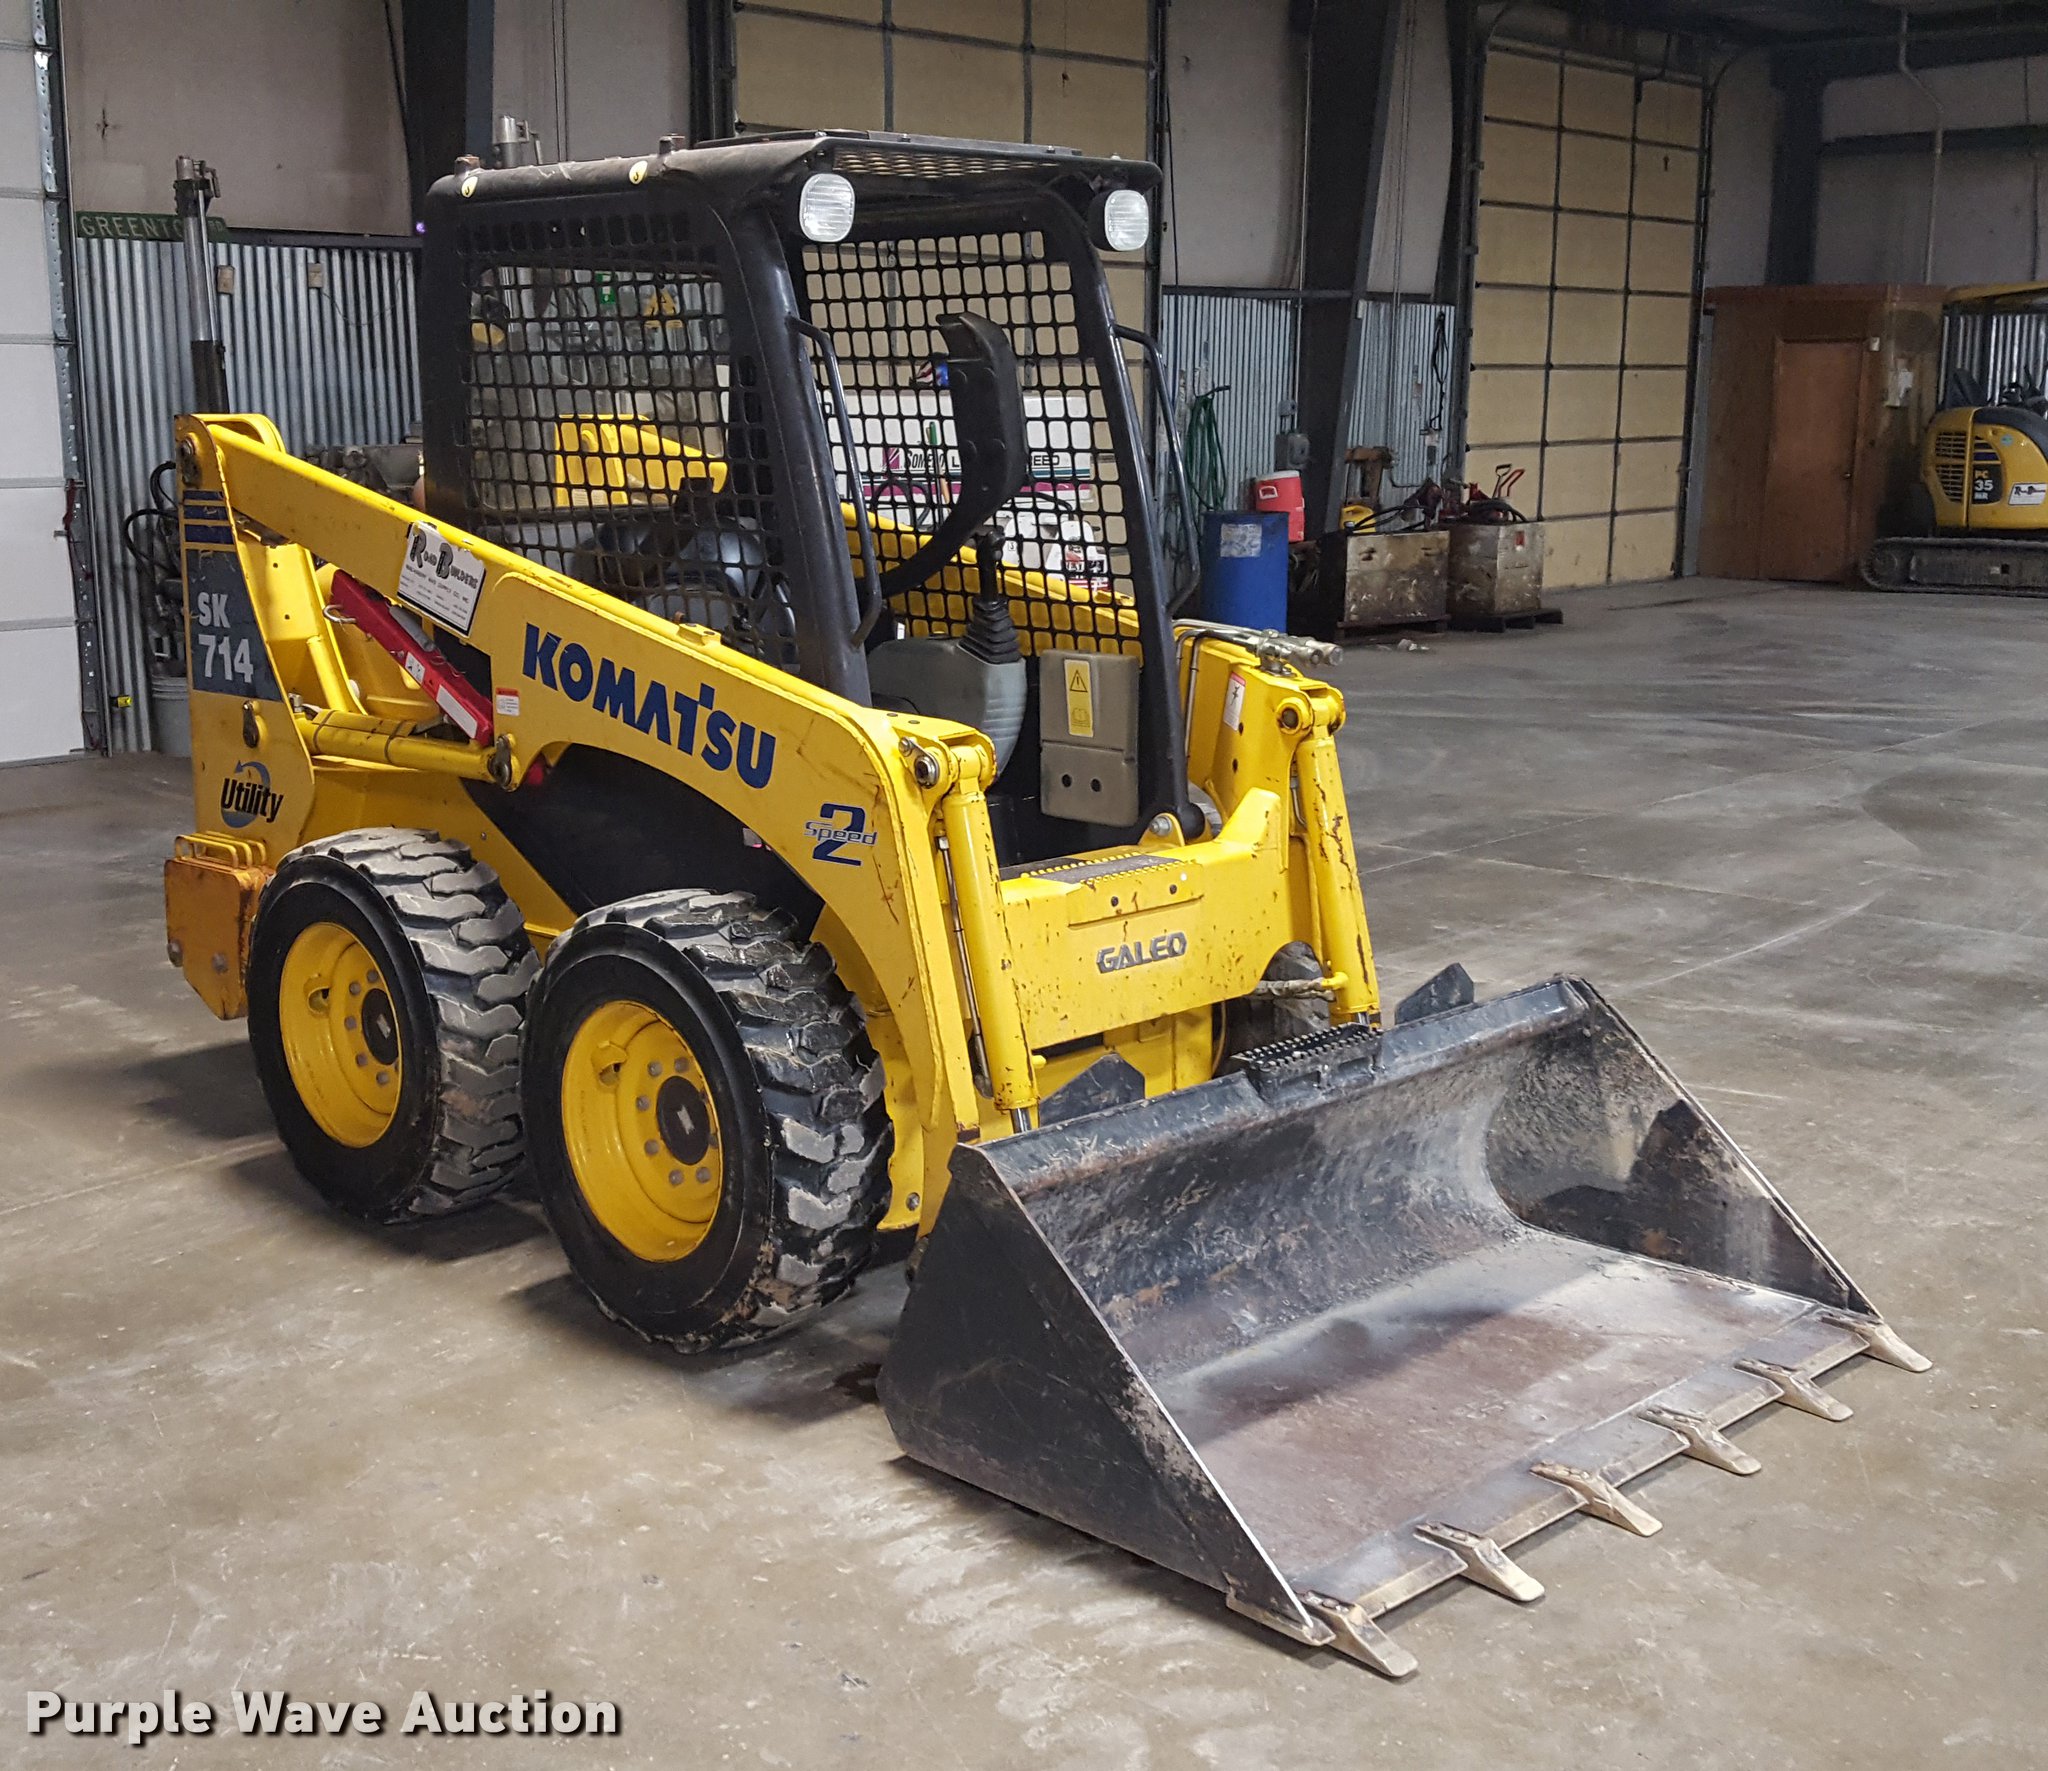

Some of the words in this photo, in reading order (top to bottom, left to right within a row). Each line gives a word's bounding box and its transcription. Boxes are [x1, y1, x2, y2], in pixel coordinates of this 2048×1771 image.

[1975, 470, 1989, 479] PC
[1975, 480, 1994, 491] 35
[197, 591, 231, 628] SK
[198, 634, 254, 684] 714
[522, 622, 777, 789] KOMATSU
[221, 778, 284, 824] Utility
[804, 821, 878, 847] Speed
[812, 803, 866, 867] 2
[1096, 931, 1188, 974] GALEO
